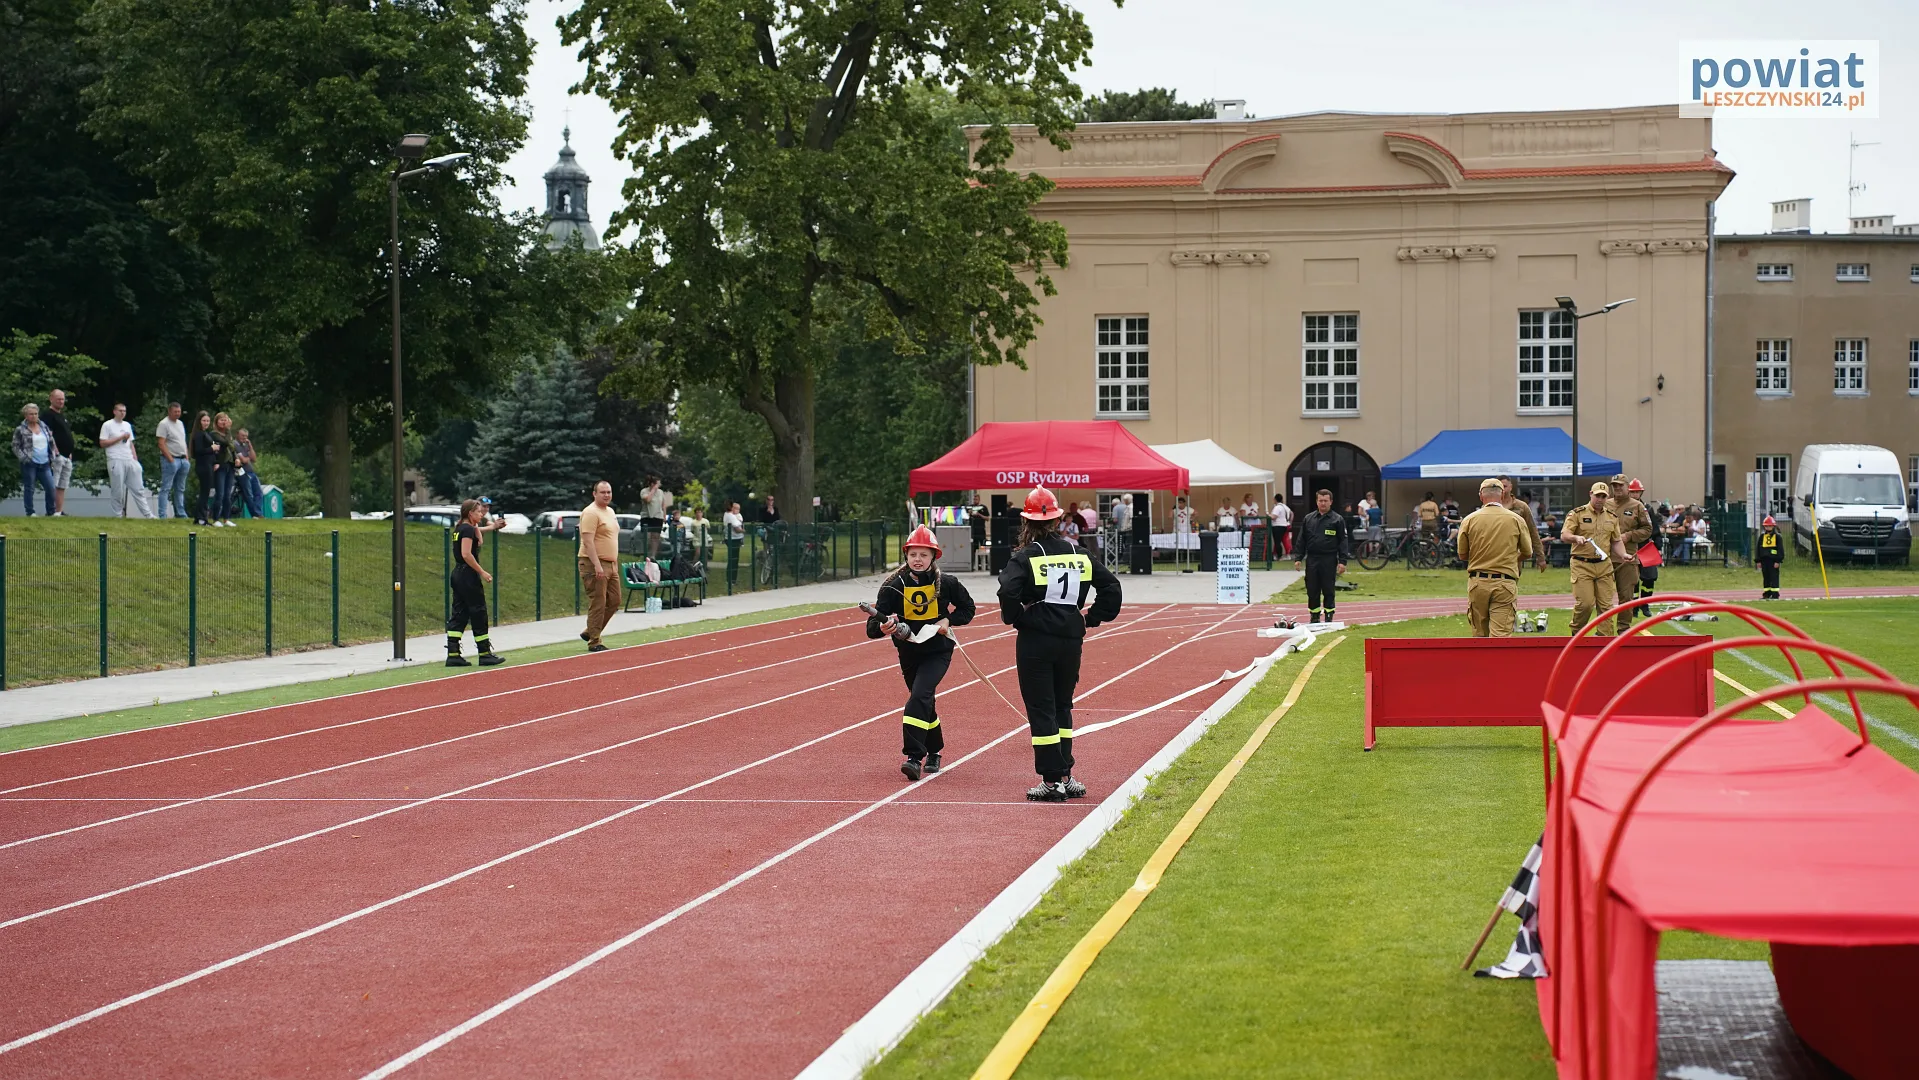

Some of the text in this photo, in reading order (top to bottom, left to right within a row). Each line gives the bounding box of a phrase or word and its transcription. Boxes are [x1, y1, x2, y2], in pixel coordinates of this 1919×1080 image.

[996, 471, 1090, 486] OSP Rydzyna
[1058, 572, 1069, 599] 1
[911, 590, 930, 616] 9
